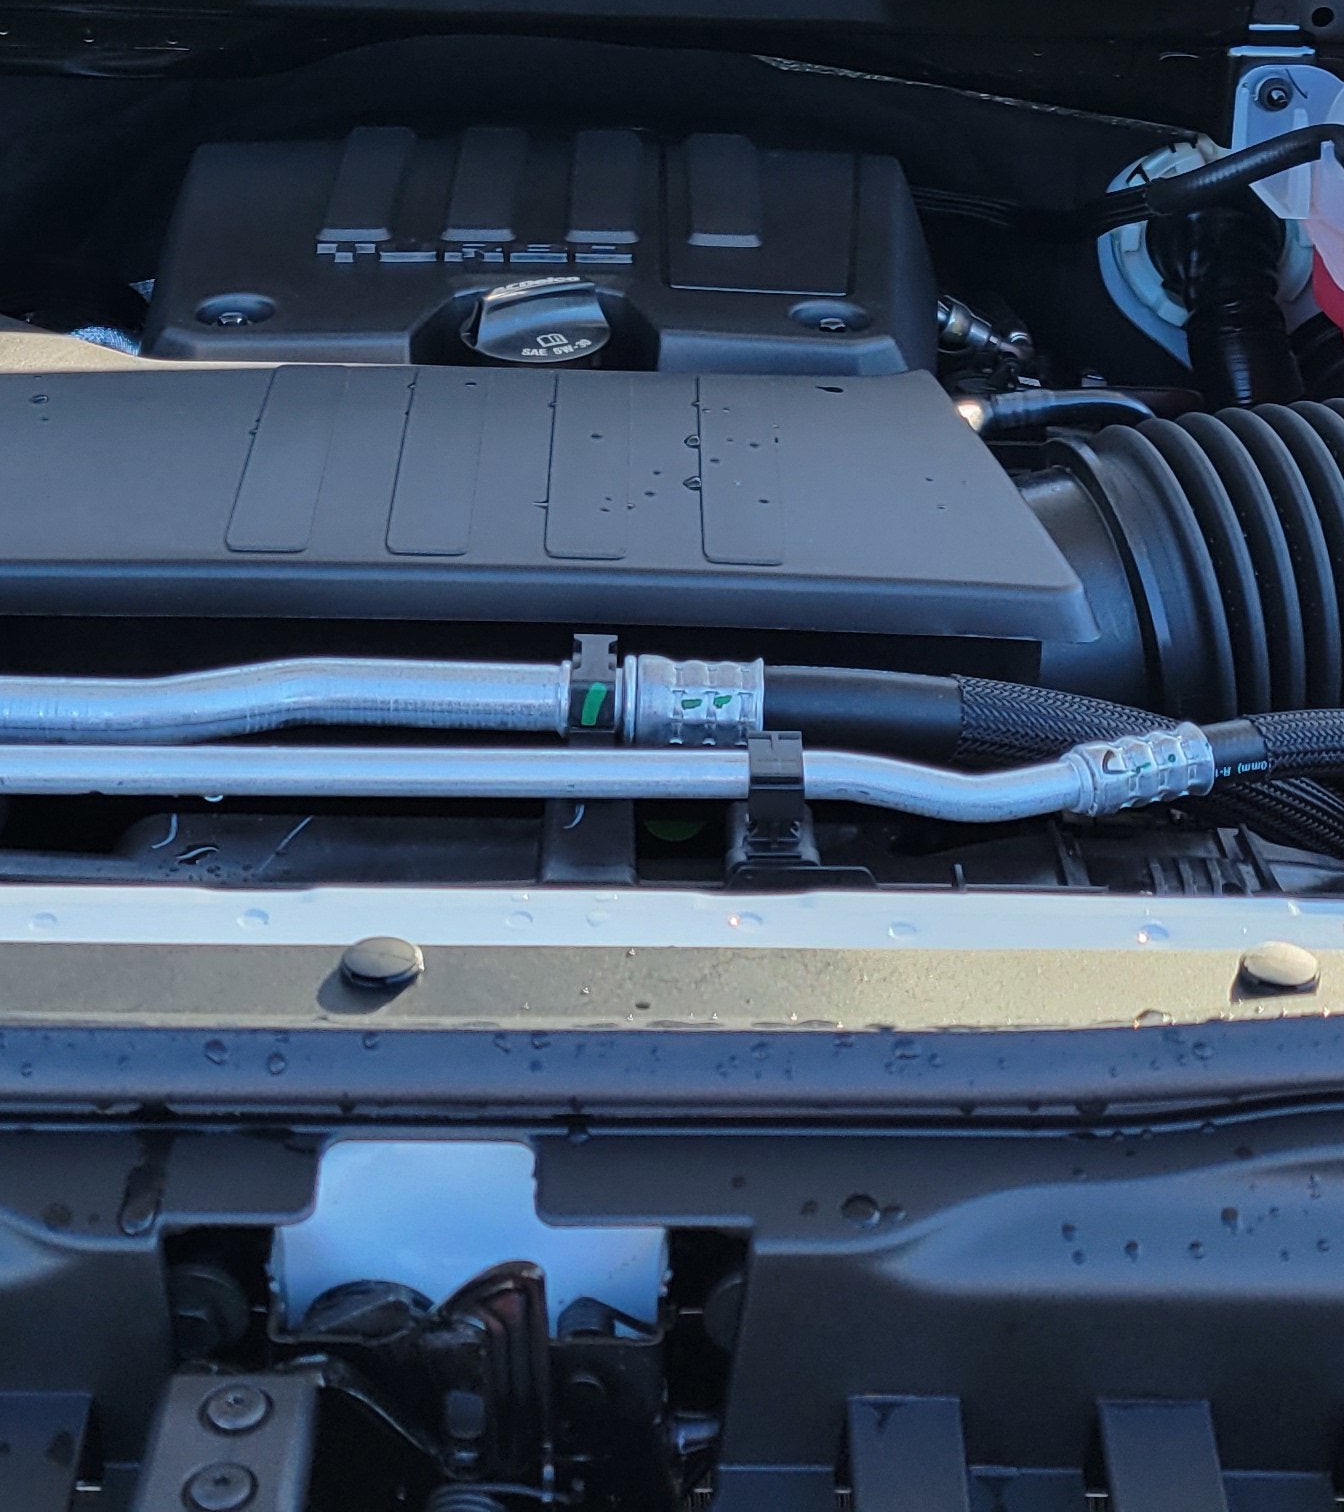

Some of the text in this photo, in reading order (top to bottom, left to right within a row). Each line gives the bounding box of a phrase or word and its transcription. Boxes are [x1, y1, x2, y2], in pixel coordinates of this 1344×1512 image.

[490, 276, 581, 294] ACDelco
[521, 347, 547, 357] SAE
[1237, 760, 1268, 774] 0mm)
